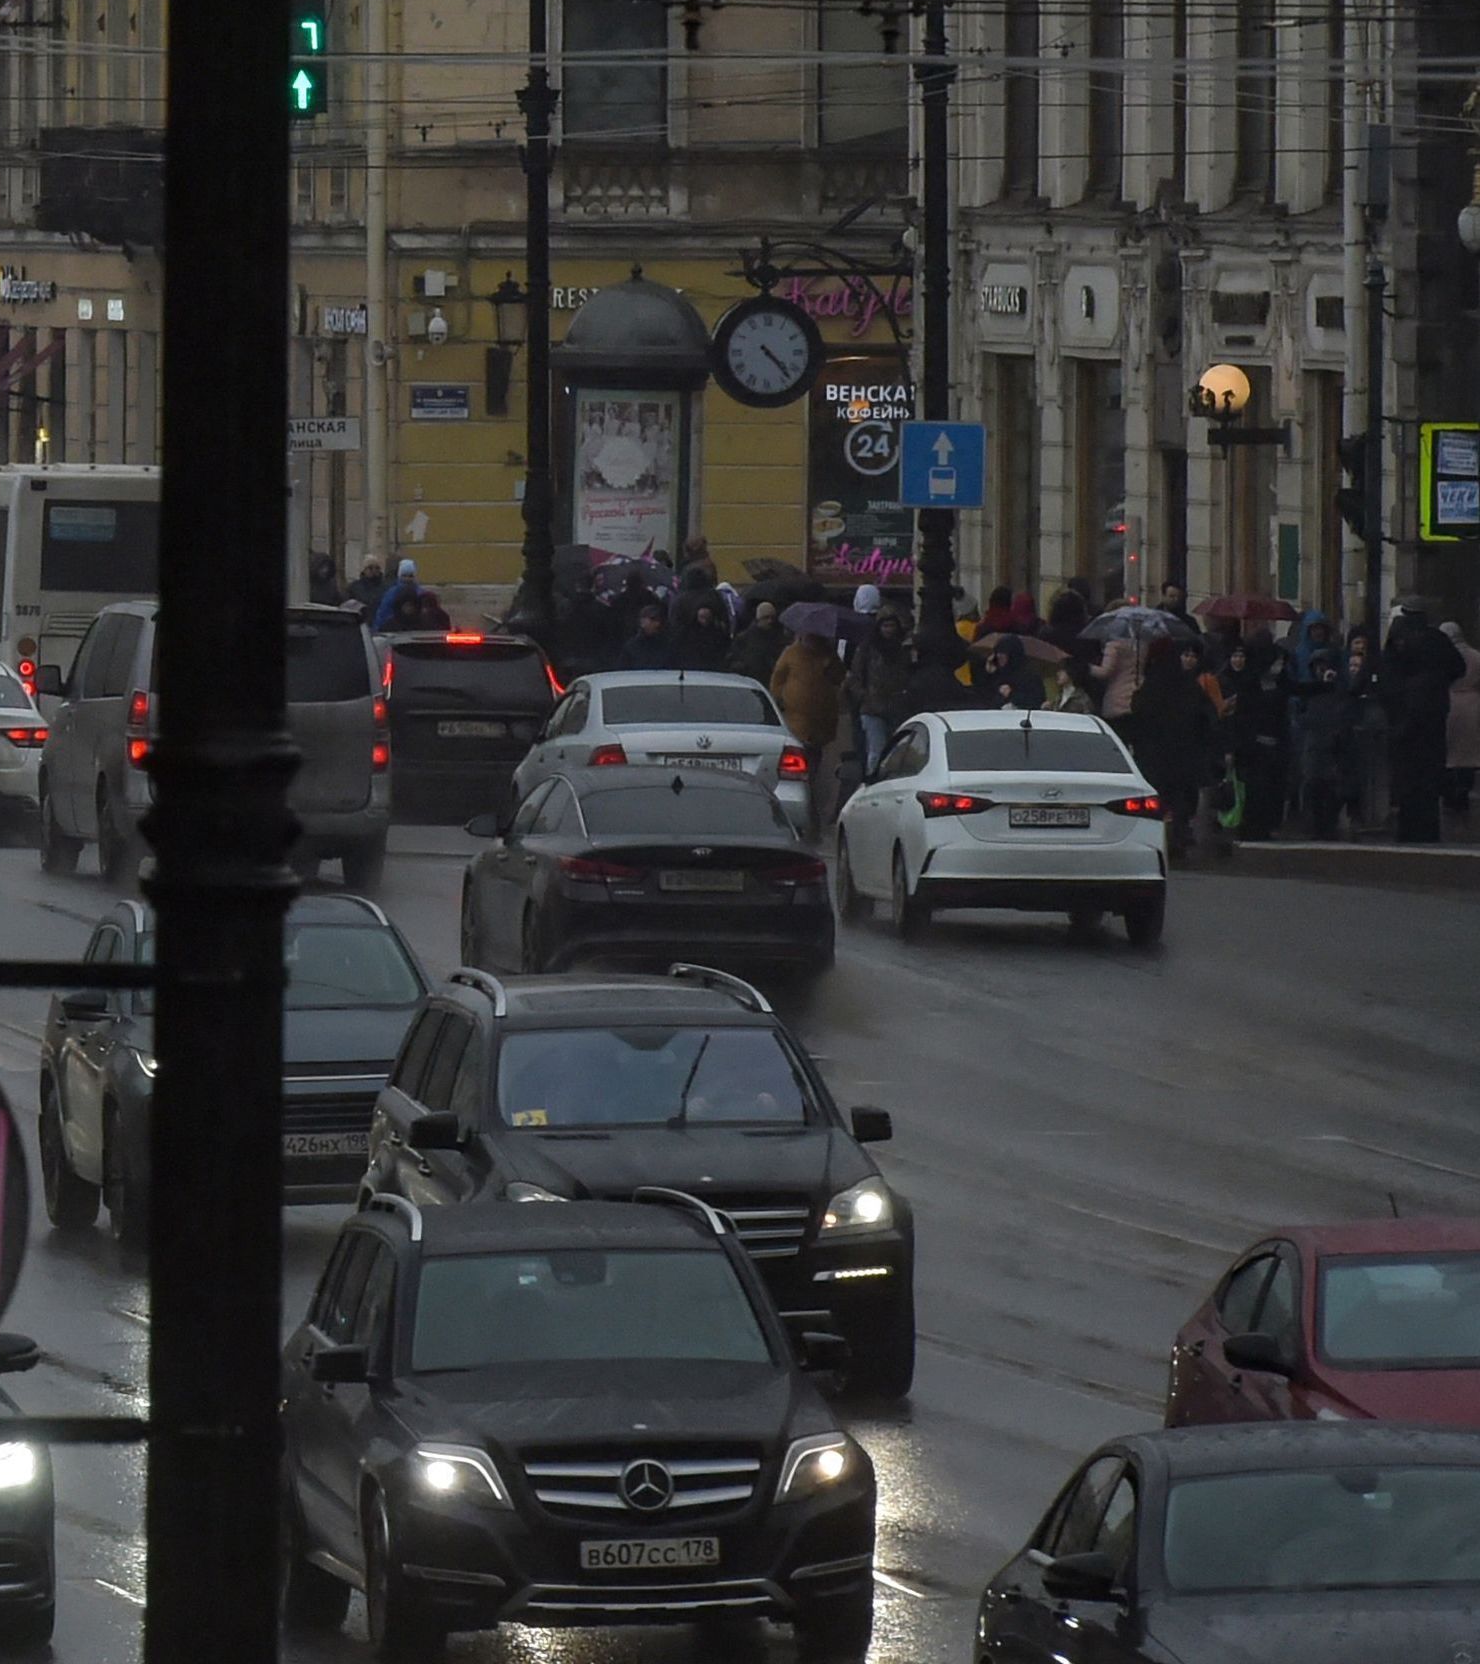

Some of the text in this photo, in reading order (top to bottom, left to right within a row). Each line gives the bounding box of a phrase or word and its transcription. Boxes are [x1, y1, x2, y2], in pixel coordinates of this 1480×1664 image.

[288, 420, 347, 433] АНСКАЯ
[289, 437, 323, 448] лица
[856, 434, 890, 458] 24
